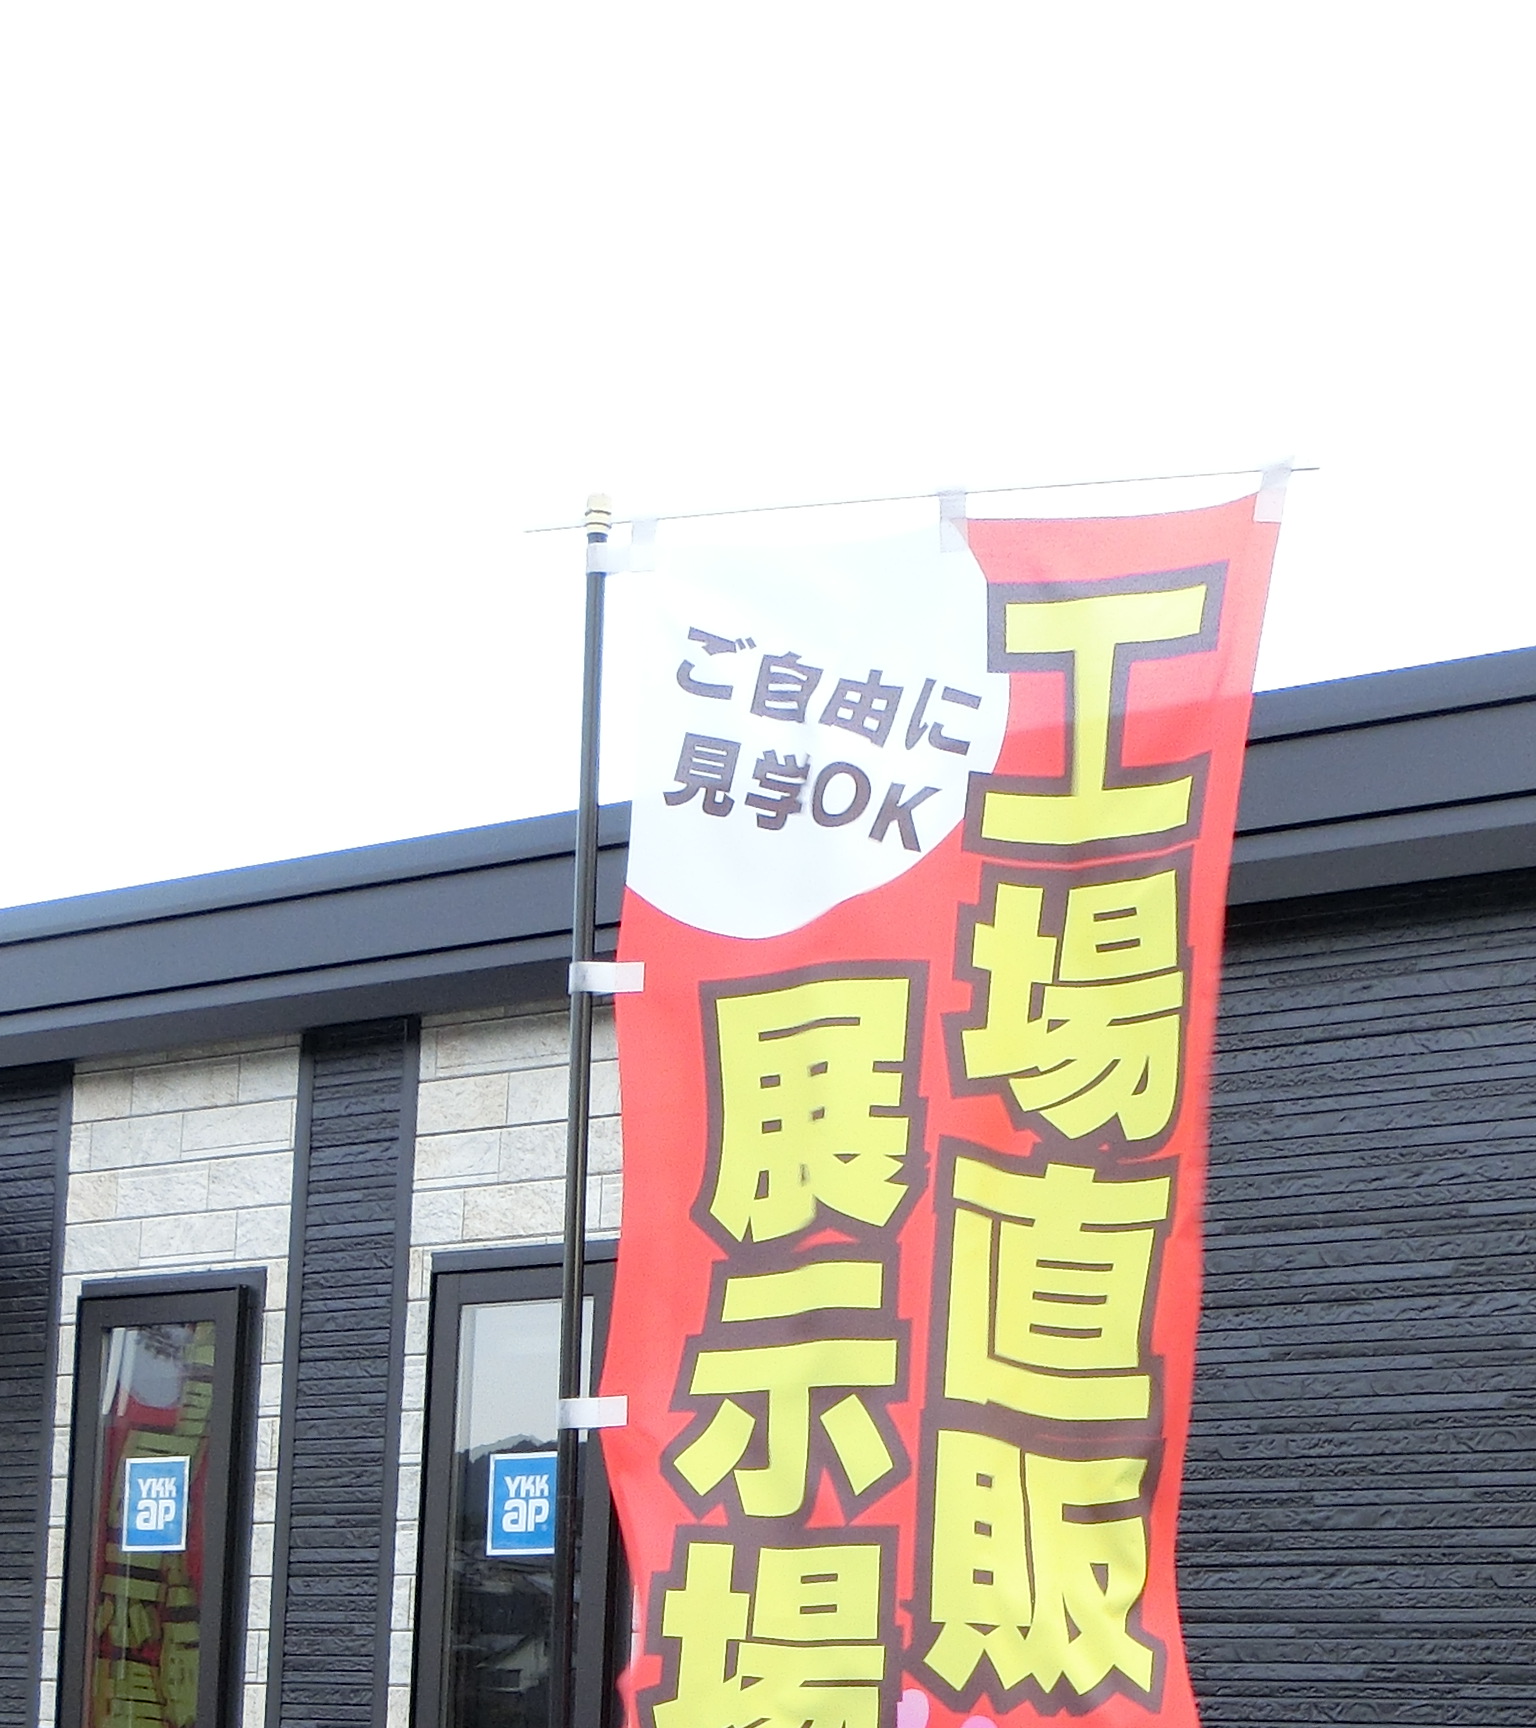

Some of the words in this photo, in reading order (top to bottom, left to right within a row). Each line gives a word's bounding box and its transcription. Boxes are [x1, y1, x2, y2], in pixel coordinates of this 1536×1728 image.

[674, 626, 983, 757] ご自由に
[661, 731, 944, 854] 見学OK
[923, 583, 1208, 1697] 工場直販
[137, 1477, 177, 1498] YKK
[504, 1474, 550, 1498] YKK
